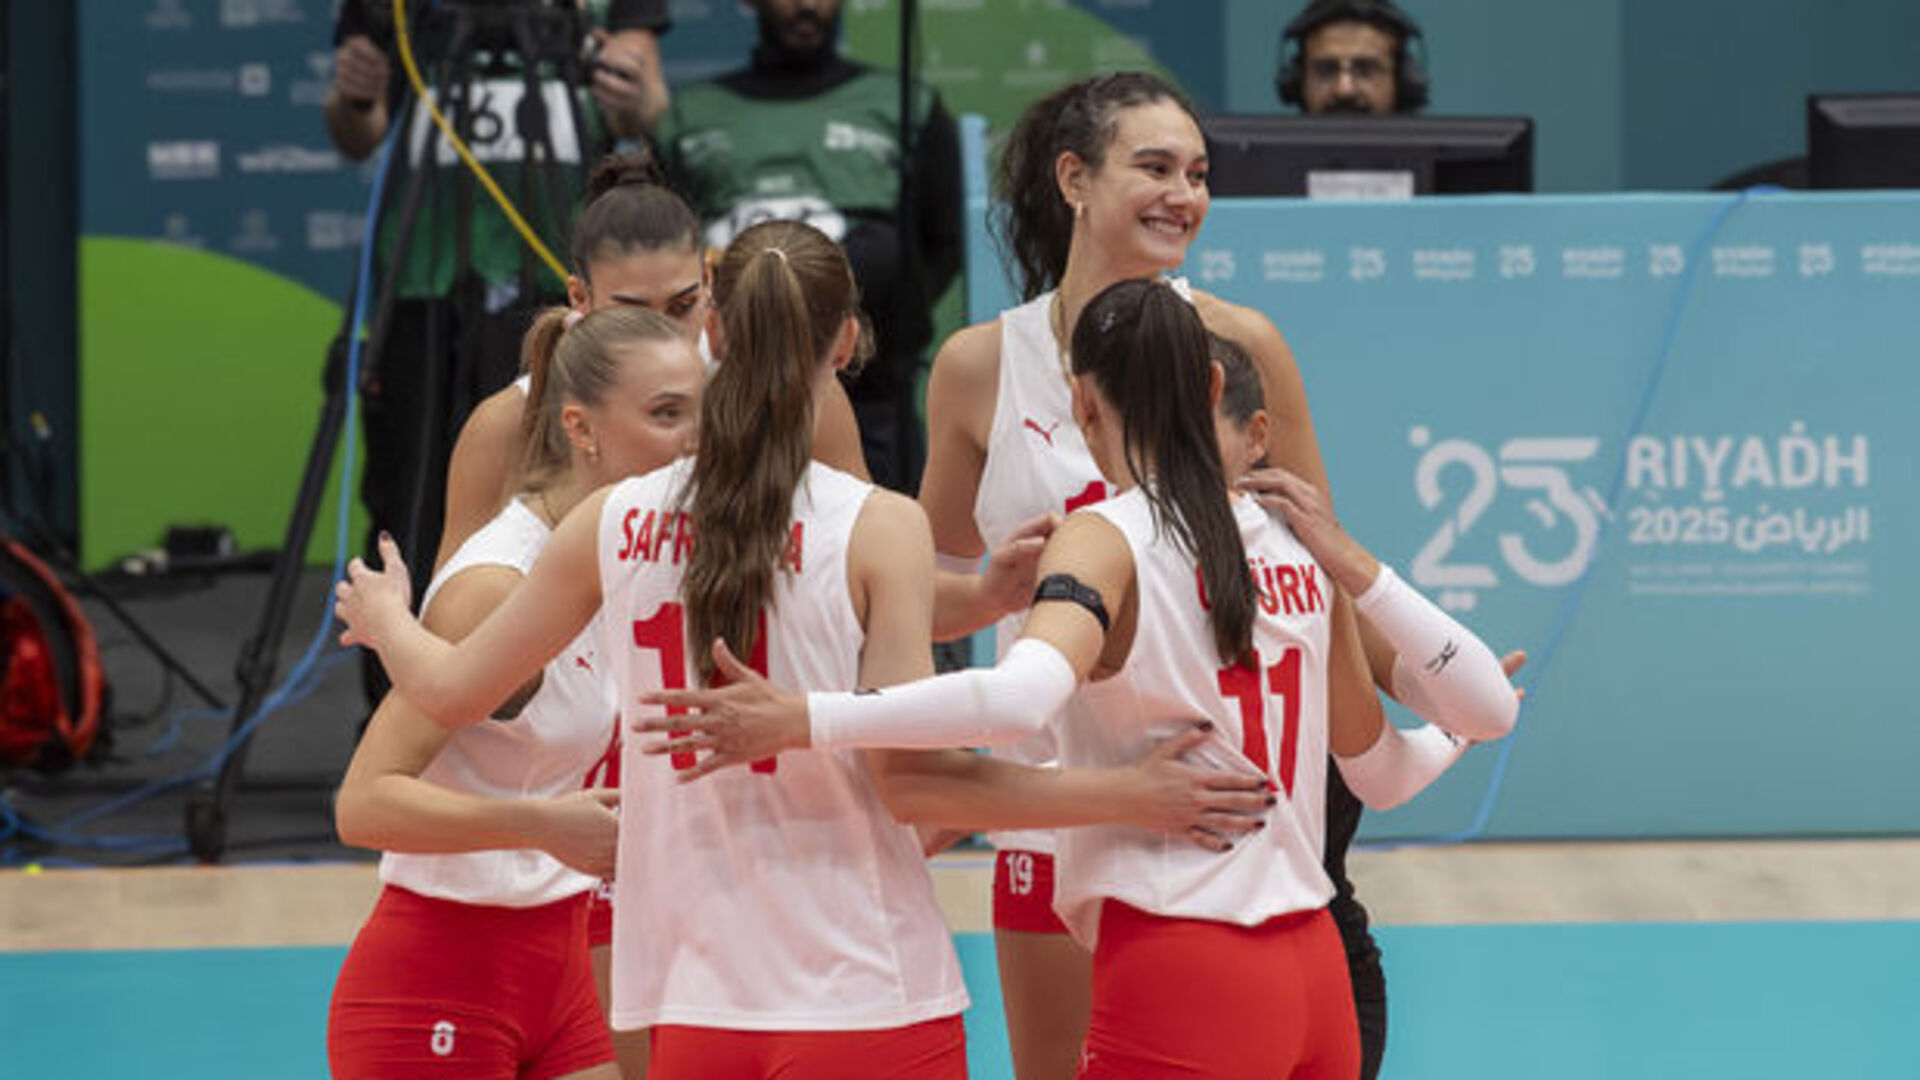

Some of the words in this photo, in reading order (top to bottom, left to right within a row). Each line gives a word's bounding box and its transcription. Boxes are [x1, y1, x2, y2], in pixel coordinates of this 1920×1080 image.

[1627, 421, 1868, 500] RIYADH
[1628, 507, 1731, 544] 2025
[1735, 503, 1869, 552] الرياض
[1217, 647, 1302, 803] 11
[1006, 853, 1034, 895] 19
